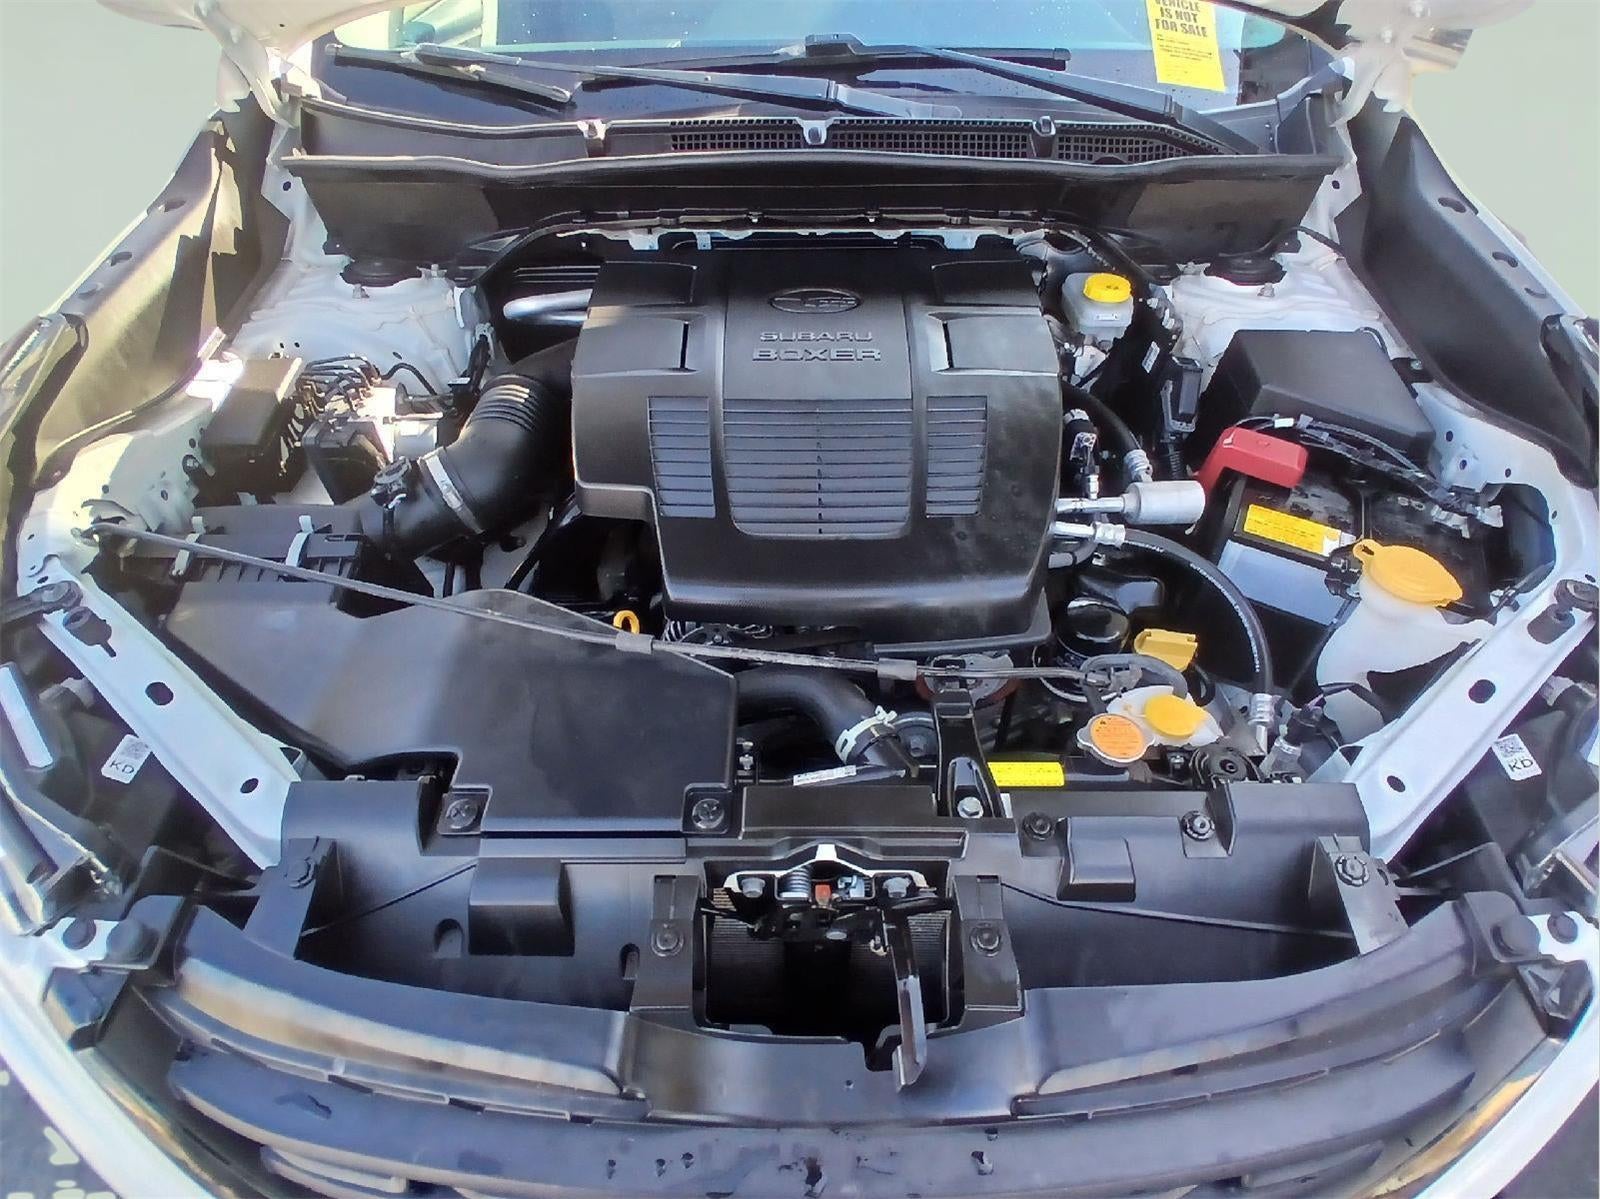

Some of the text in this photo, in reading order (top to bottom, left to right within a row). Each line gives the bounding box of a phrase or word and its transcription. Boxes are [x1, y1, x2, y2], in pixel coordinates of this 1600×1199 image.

[1160, 7, 1198, 23] IS NOT
[1155, 19, 1208, 37] FOR SALE
[760, 331, 873, 342] SUBARU
[752, 348, 881, 361] BOXER
